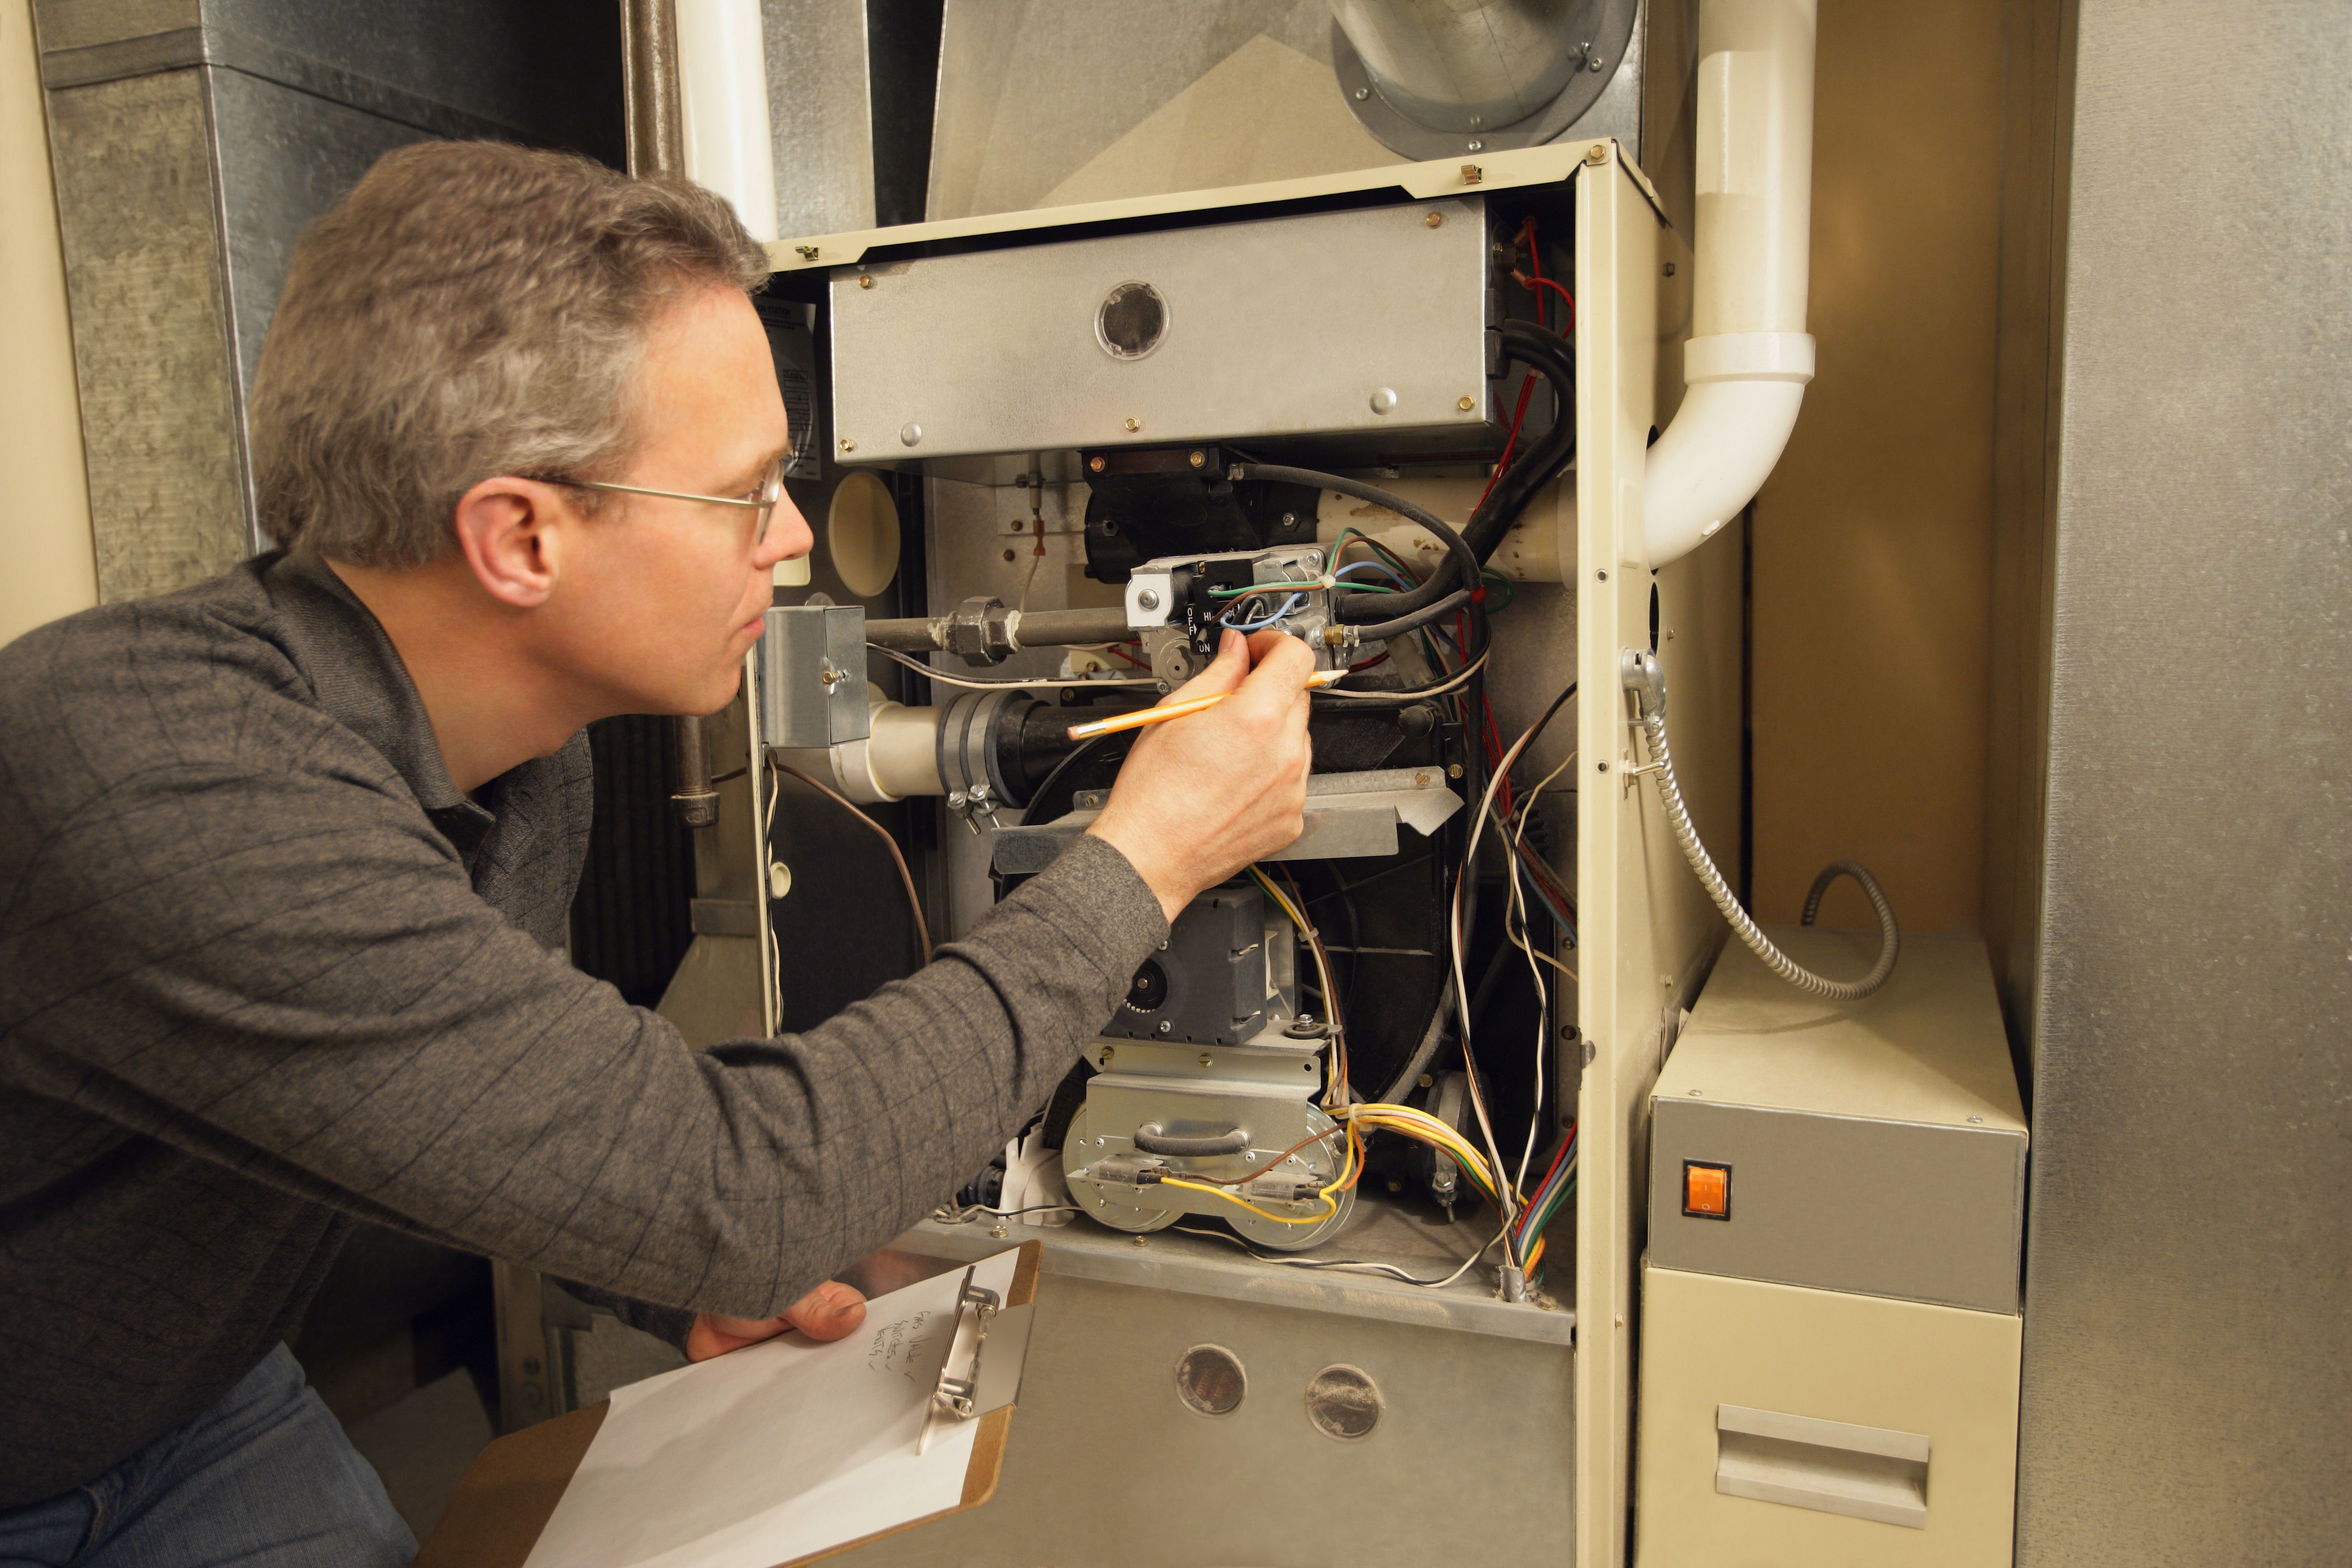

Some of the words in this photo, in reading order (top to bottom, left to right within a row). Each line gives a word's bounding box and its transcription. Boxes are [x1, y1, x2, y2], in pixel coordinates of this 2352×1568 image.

[1203, 611, 1212, 621] HI
[1199, 643, 1210, 652] ON
[912, 1311, 930, 1329] GAS
